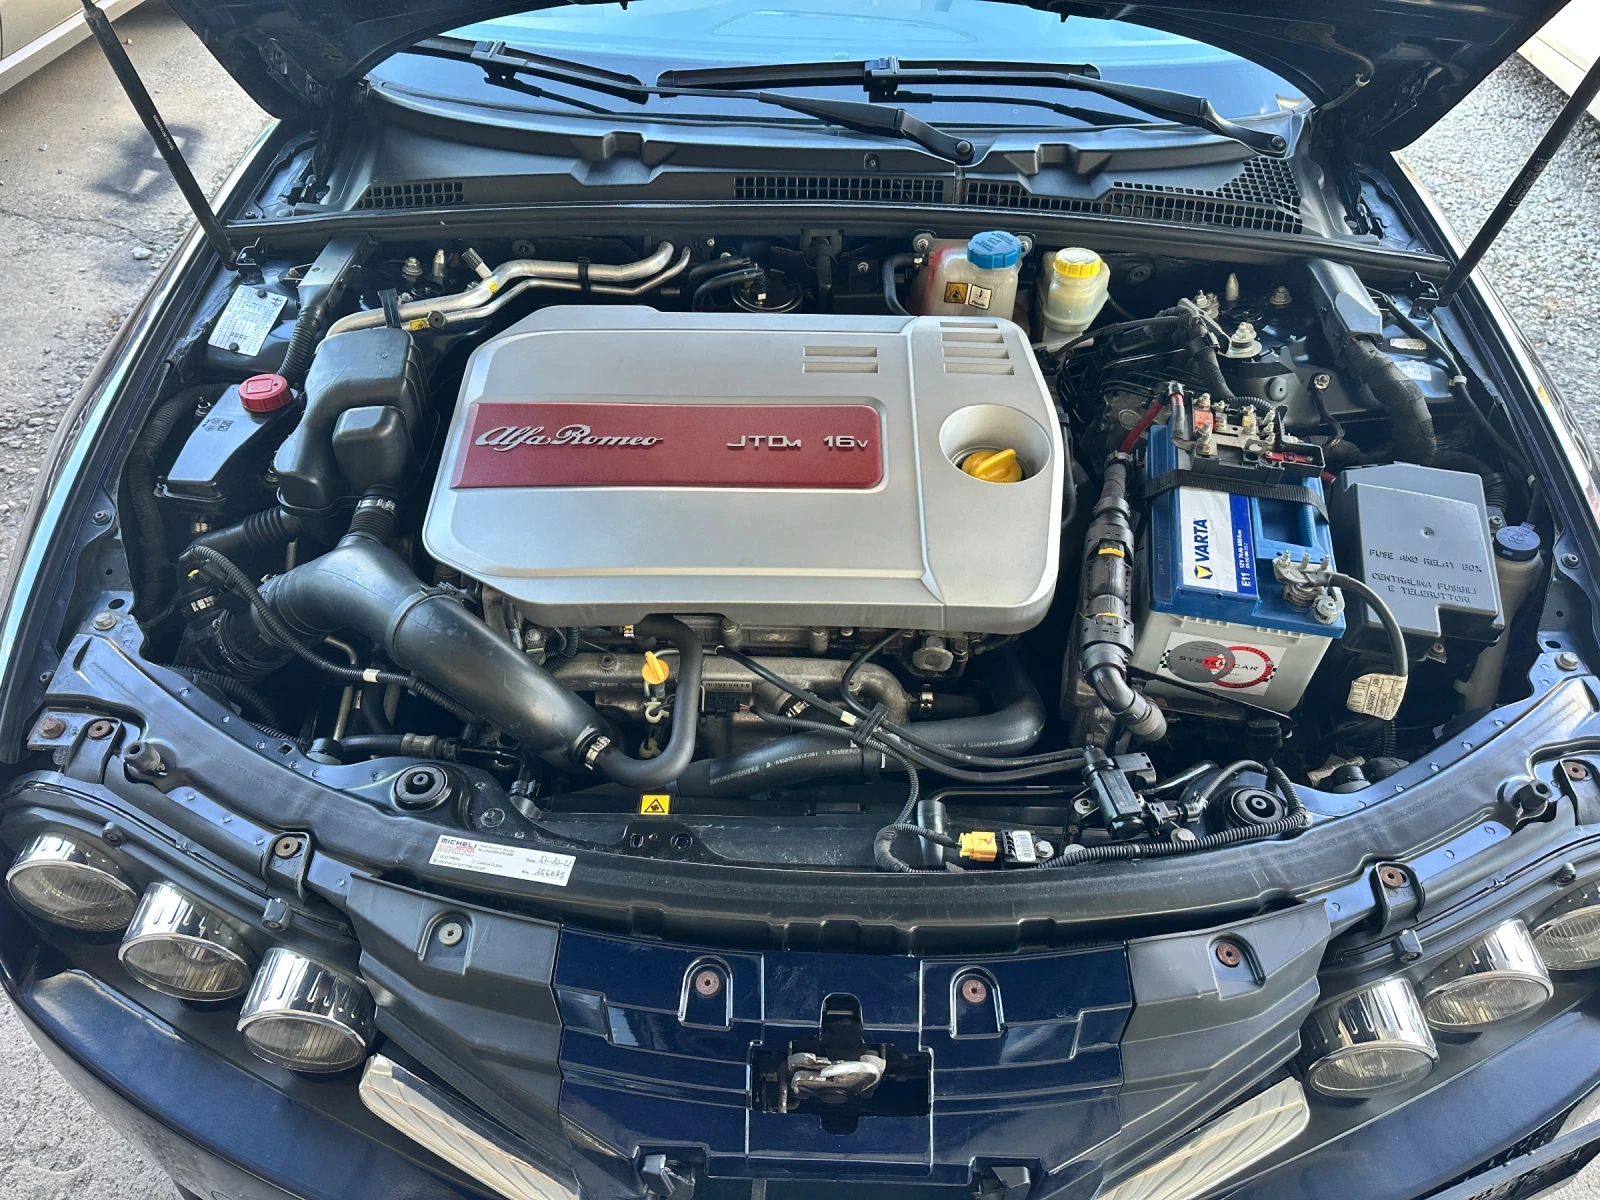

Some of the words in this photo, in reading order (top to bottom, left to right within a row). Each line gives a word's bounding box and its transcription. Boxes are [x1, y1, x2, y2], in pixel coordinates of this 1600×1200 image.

[475, 426, 551, 452] Alfa
[550, 423, 664, 447] Romeo
[1193, 519, 1210, 562] VARTA
[1369, 549, 1394, 560] FUSE
[1400, 555, 1418, 564] AND
[1424, 558, 1455, 569] RELAY
[1462, 564, 1483, 573] BOX
[1240, 572, 1252, 587] E11
[1372, 572, 1432, 588] CENTRALINA
[1438, 582, 1477, 595] FUSIBILI
[1388, 584, 1395, 592] E
[1400, 586, 1471, 604] TELERUTTORI
[441, 838, 478, 849] MICHELI
